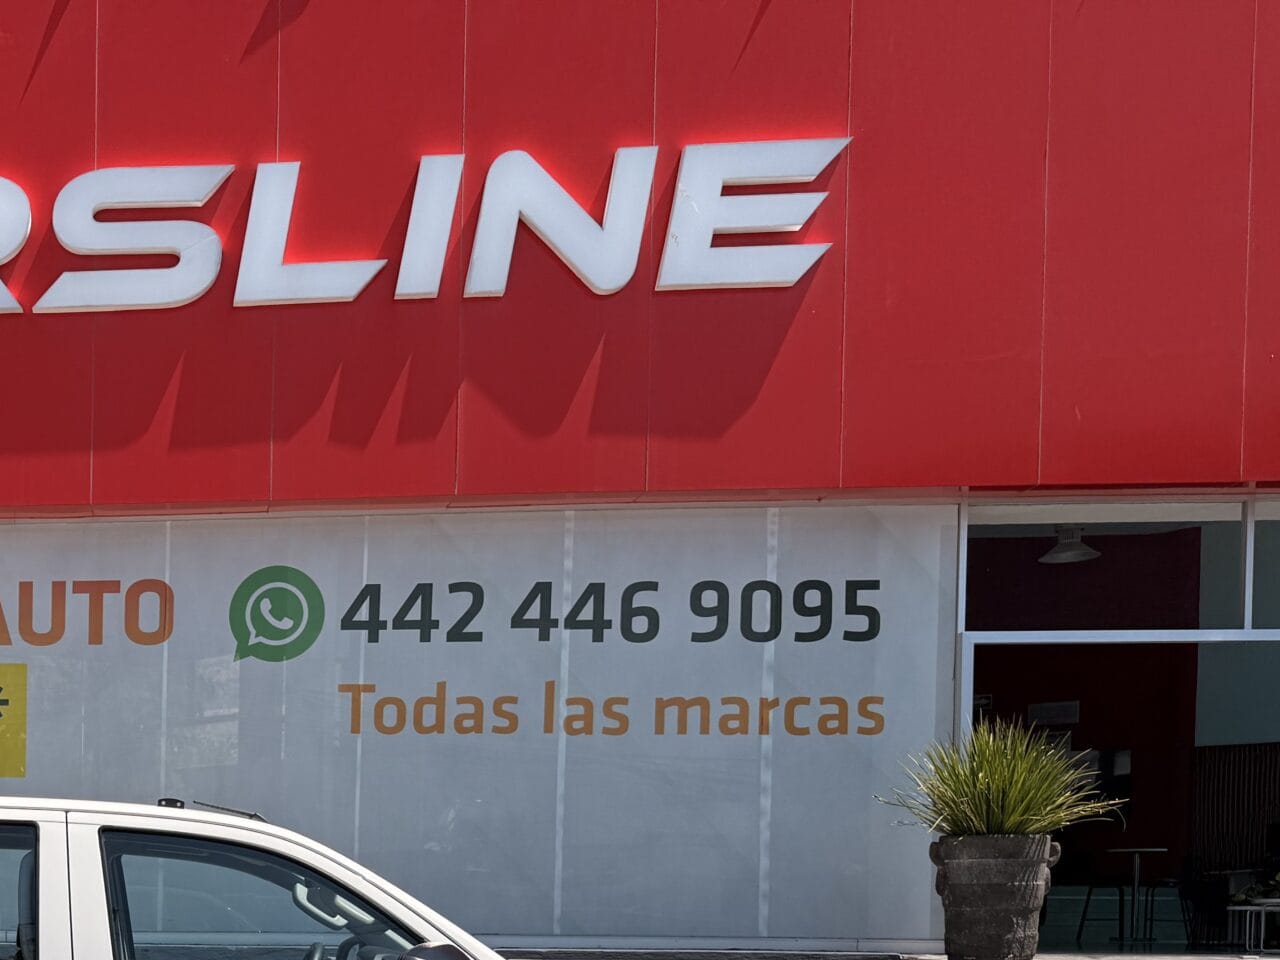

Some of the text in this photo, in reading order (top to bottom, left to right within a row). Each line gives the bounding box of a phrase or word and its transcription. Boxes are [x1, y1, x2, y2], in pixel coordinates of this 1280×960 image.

[340, 579, 881, 643] 442 446 9095
[338, 680, 885, 737] Todas las marcas
